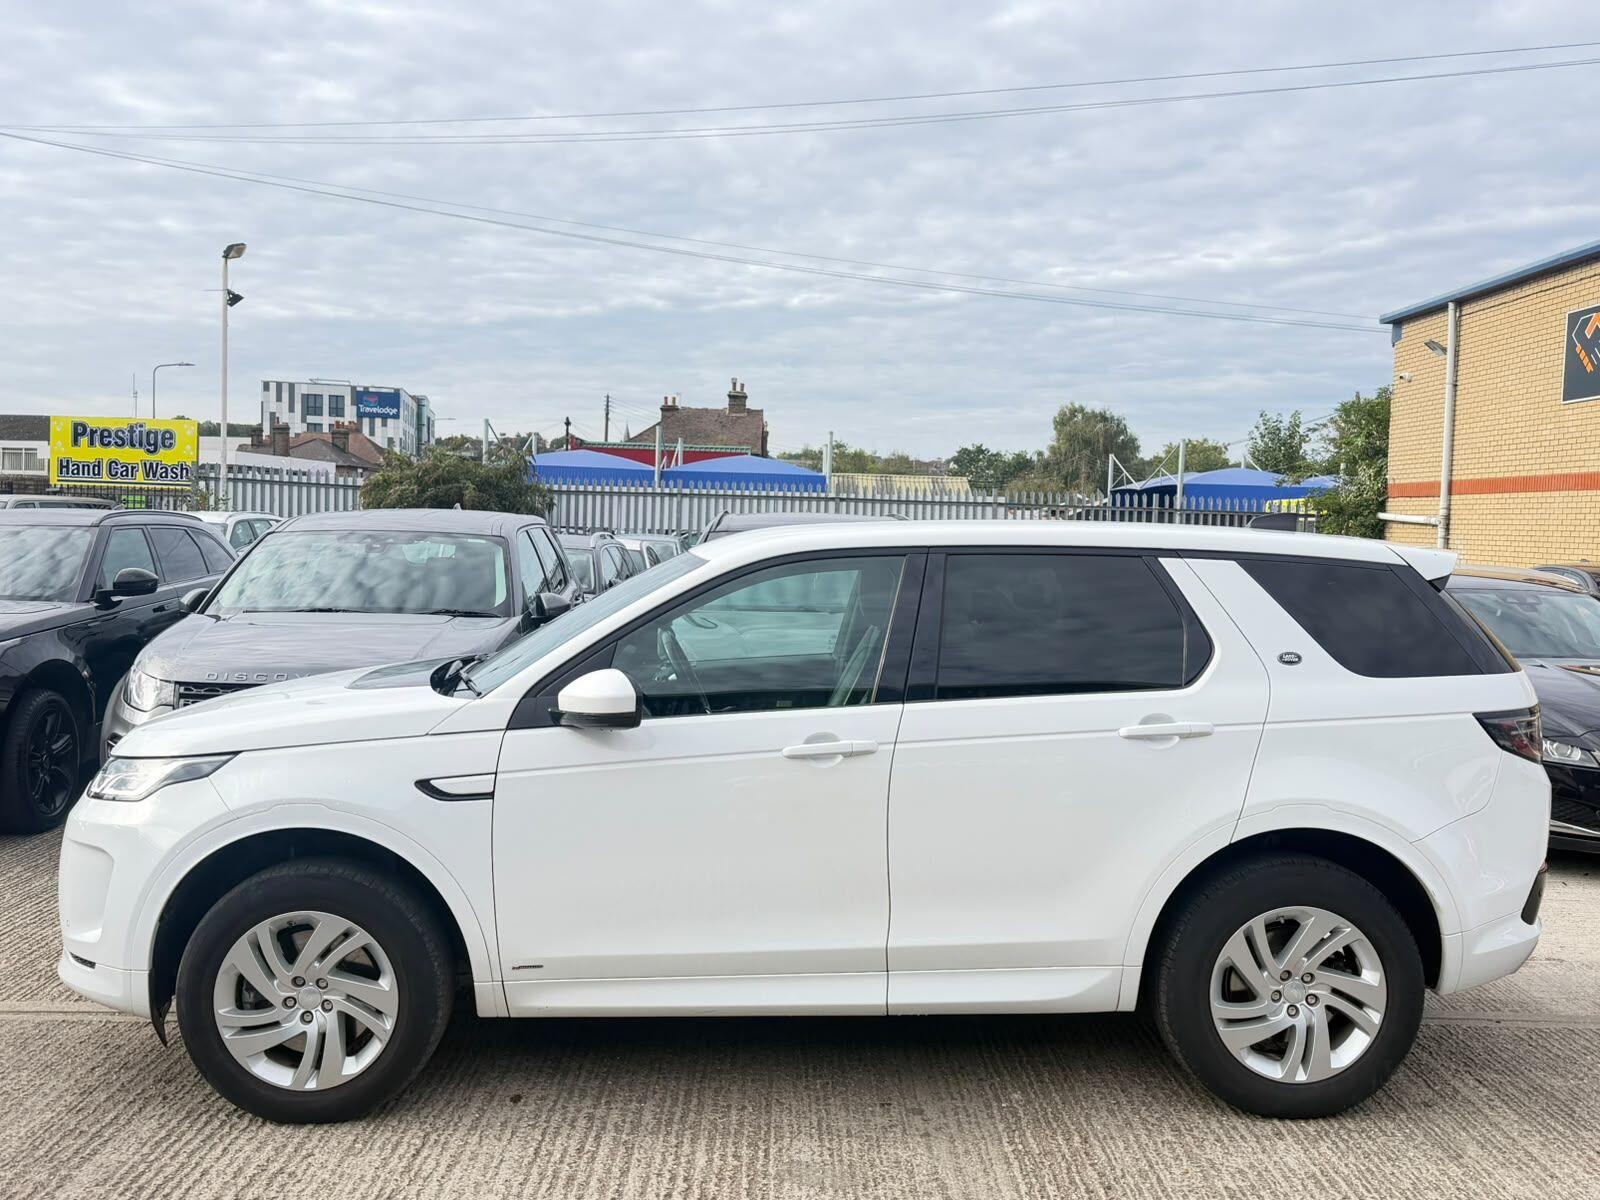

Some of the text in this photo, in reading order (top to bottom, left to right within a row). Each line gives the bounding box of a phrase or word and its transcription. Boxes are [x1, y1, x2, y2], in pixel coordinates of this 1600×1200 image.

[358, 404, 398, 416] Travelodge
[71, 420, 176, 455] Prestige
[57, 457, 191, 481] Hand Car Wash
